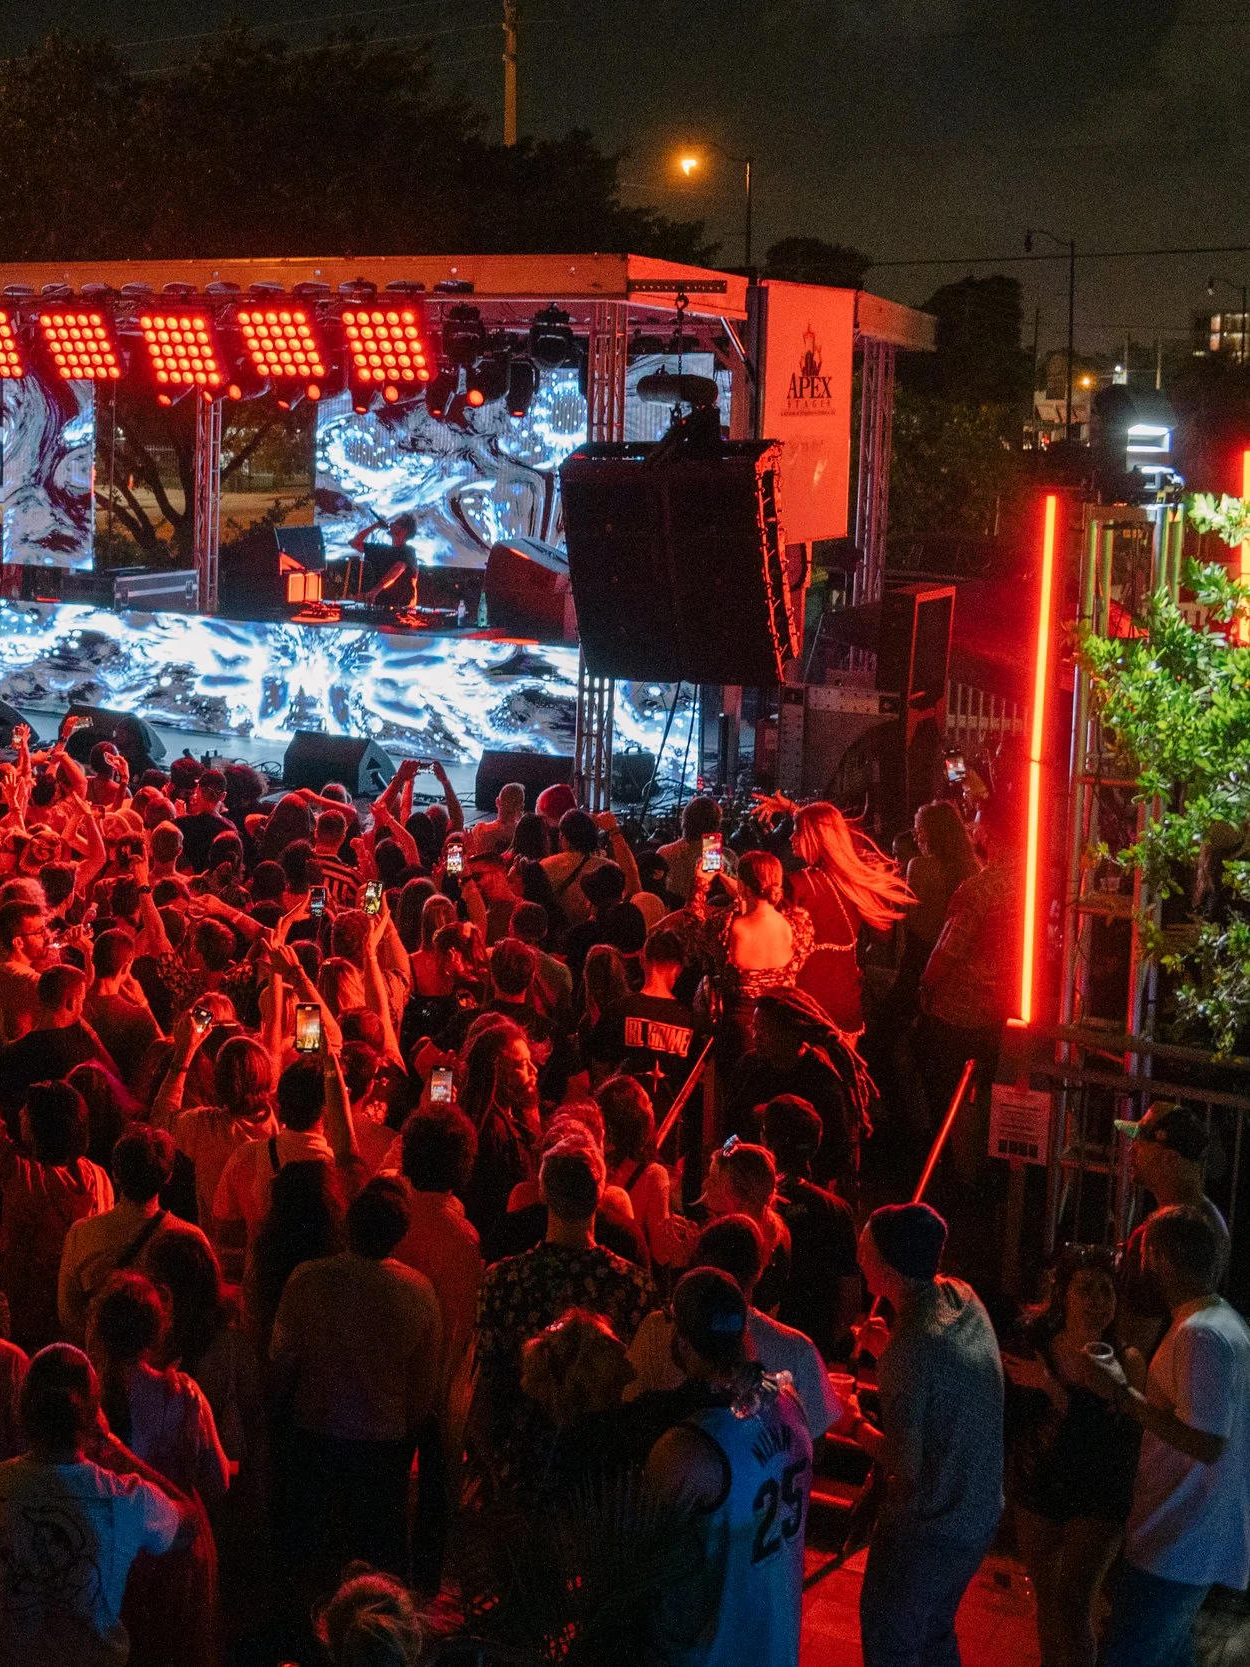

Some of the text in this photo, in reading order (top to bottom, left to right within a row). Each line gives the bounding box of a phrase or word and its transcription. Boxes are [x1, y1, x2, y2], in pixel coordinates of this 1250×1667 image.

[786, 373, 832, 399] APEX
[787, 400, 831, 409] STAGES
[753, 1457, 808, 1565] 25
